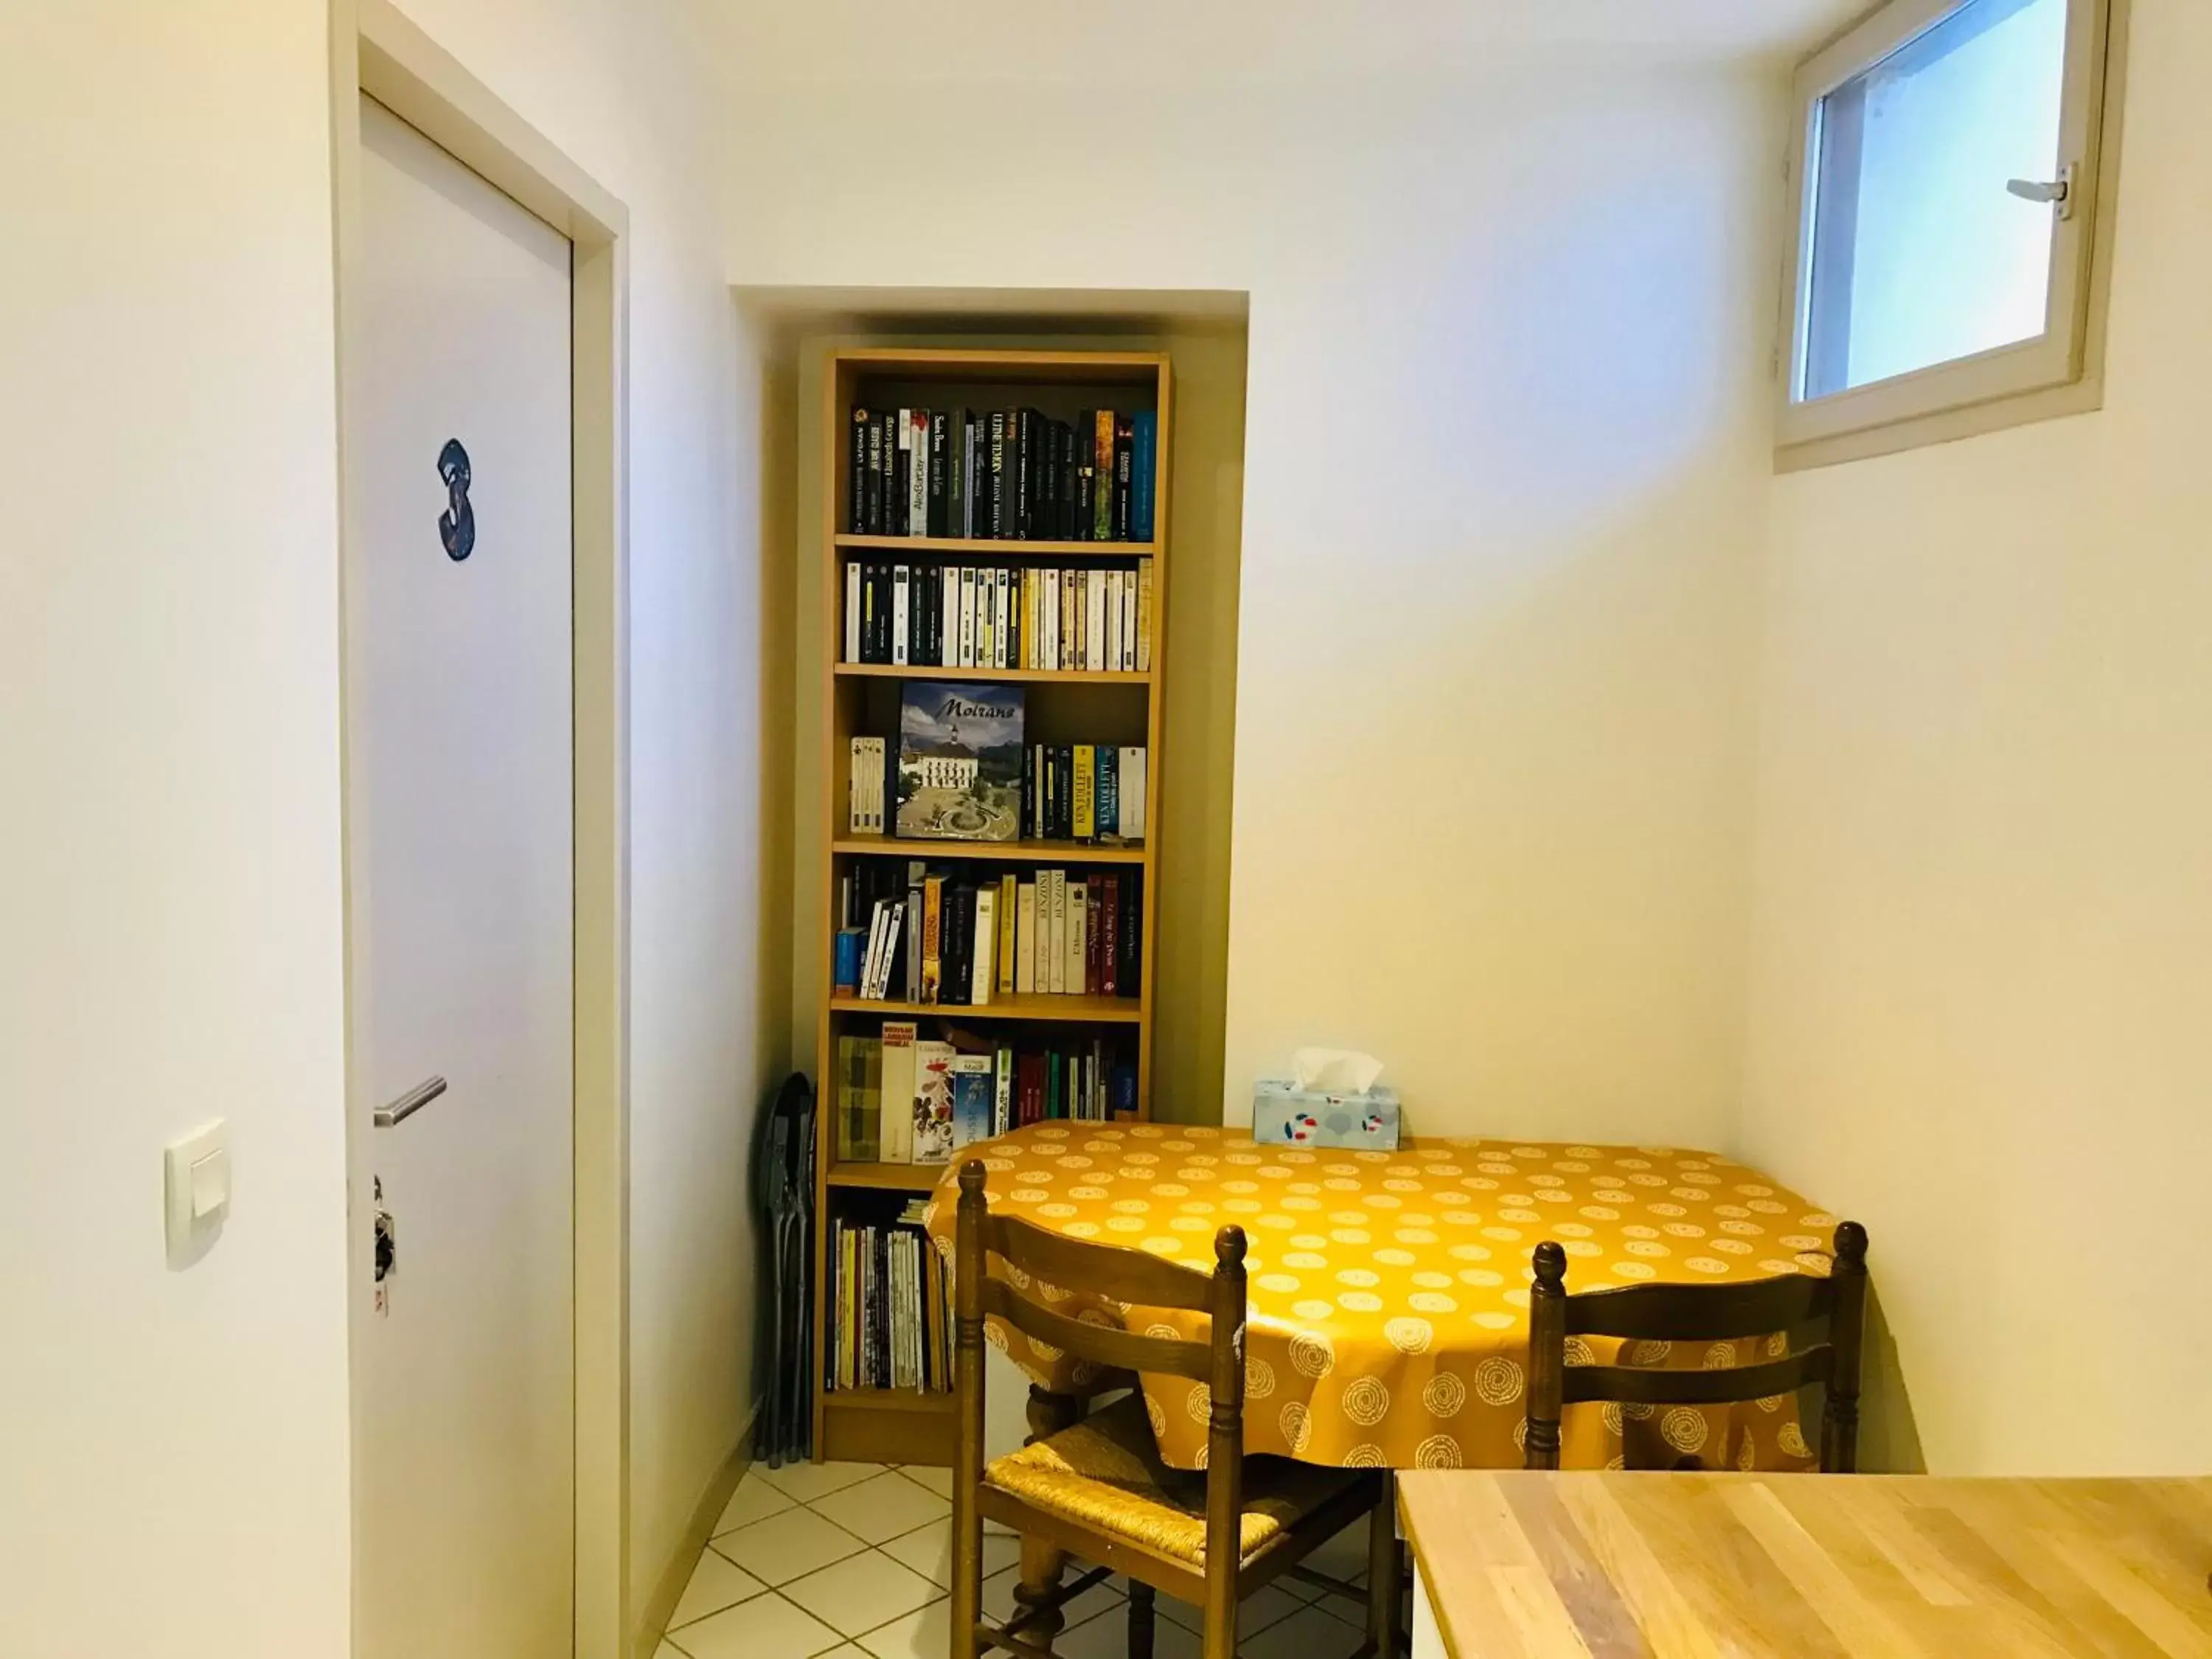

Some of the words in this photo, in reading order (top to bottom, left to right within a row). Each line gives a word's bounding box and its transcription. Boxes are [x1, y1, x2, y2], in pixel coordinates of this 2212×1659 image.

[437, 437, 476, 562] 3
[936, 699, 1015, 719] Moirans
[1076, 762, 1086, 804] FOLLETT
[1076, 805, 1086, 824] KEN
